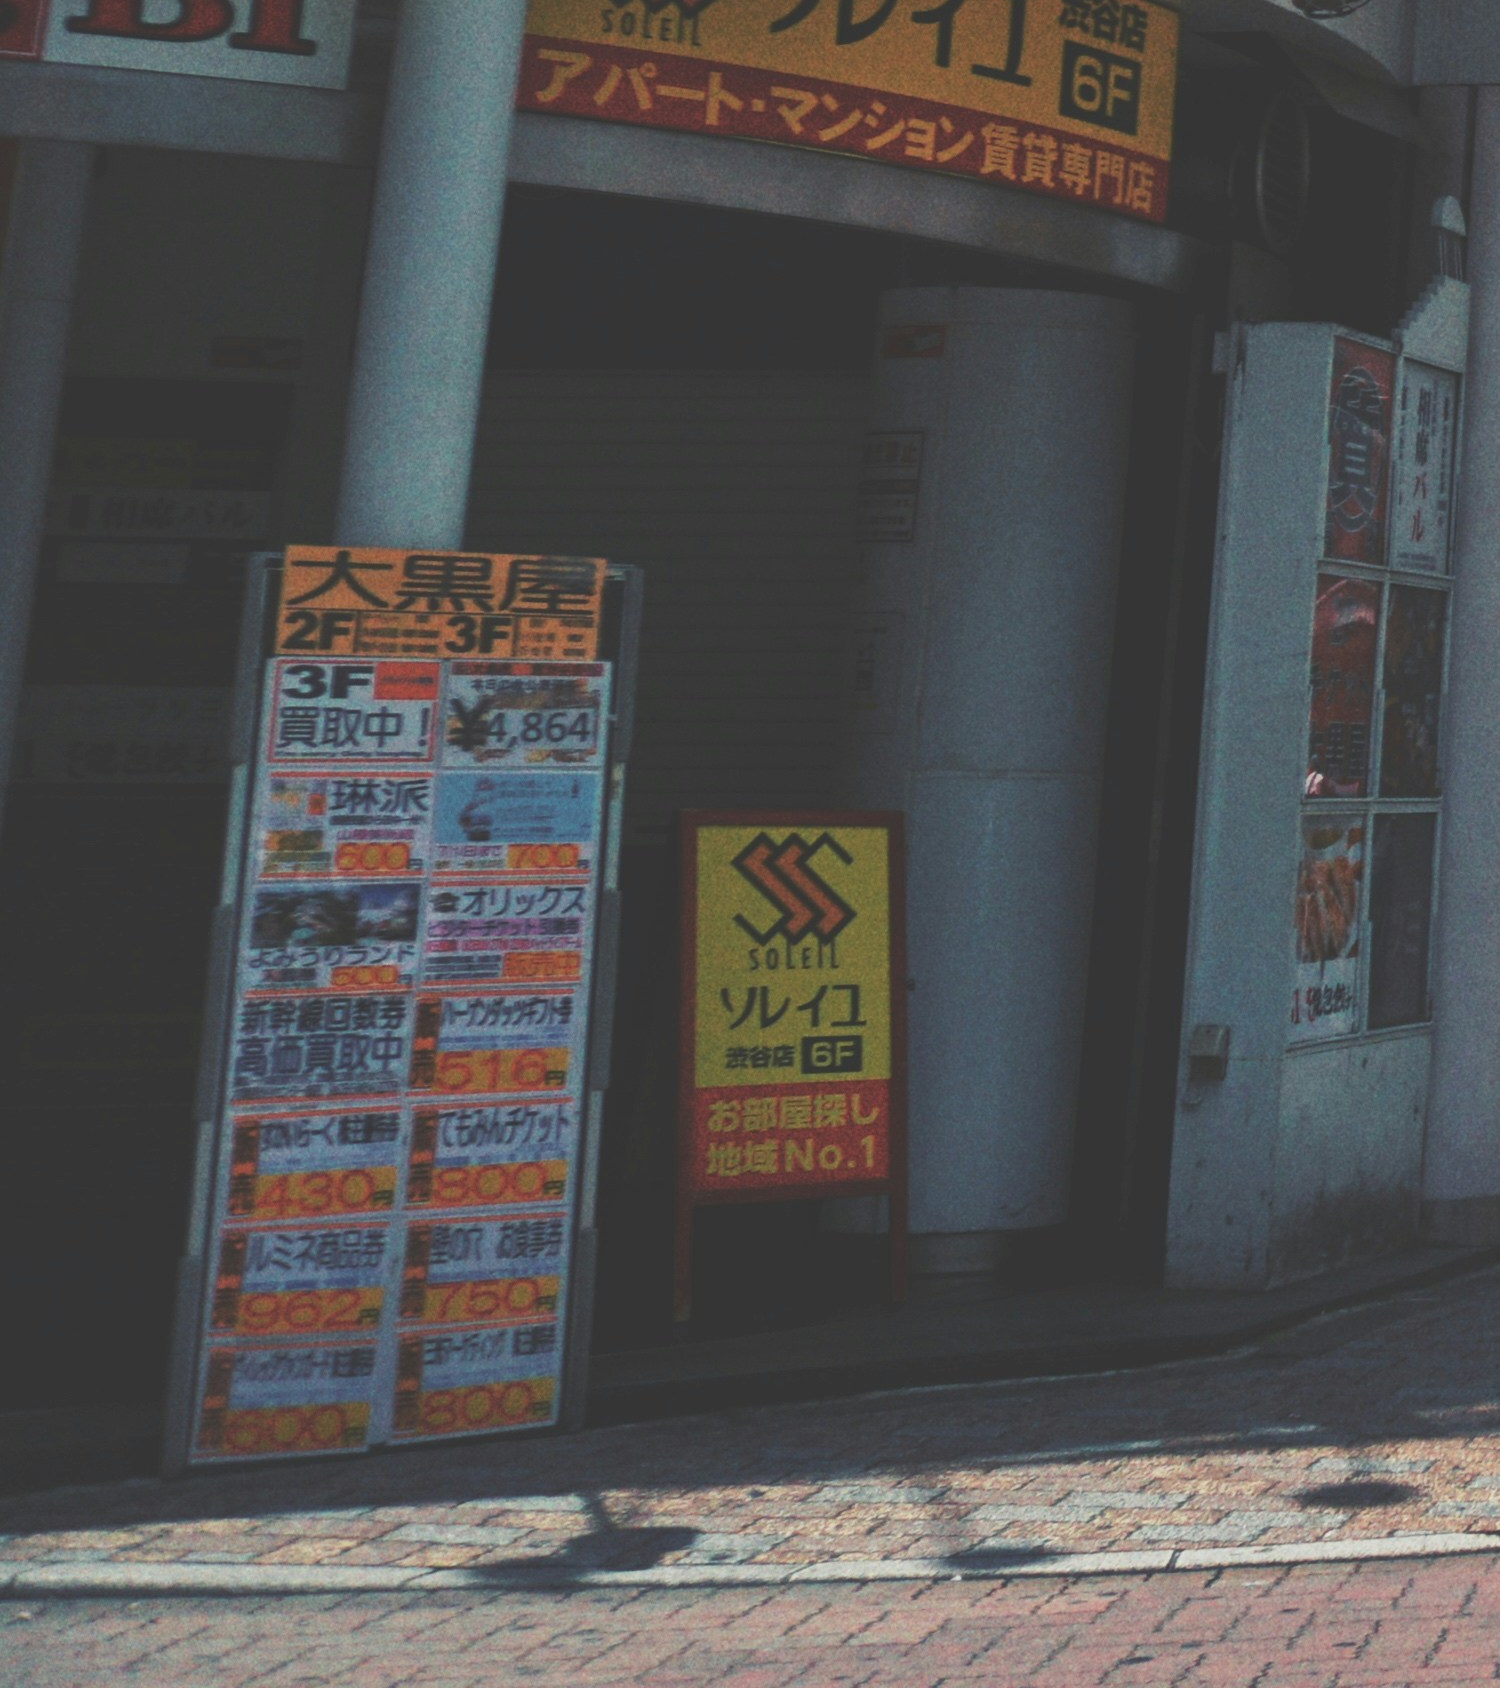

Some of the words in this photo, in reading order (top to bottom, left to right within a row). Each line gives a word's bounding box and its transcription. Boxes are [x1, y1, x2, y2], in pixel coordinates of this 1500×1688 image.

[598, 8, 700, 47] SOLEIL
[1071, 64, 1133, 118] 6F
[533, 48, 1155, 216] アパート・マンション賃貸専門店
[286, 550, 601, 614] 大黒屋
[280, 614, 355, 651] 2F
[444, 616, 513, 654] 3F
[282, 665, 374, 700] 3F
[275, 705, 432, 750] 買取中!
[328, 780, 431, 814] 琳派
[463, 887, 587, 916] オリックス
[249, 945, 417, 969] よみうりランド
[748, 937, 840, 971] SOLEIL
[242, 998, 408, 1034] 新幹線回数券
[721, 983, 867, 1031] ソレイユ
[236, 1033, 402, 1075] 高価買取中
[435, 1050, 567, 1091] 516円
[724, 1044, 794, 1069] 渋谷店
[810, 1040, 855, 1068] 6F
[706, 1091, 879, 1134] お部屋探し
[706, 1134, 876, 1178] 地域No.1
[434, 1160, 564, 1203] 800円
[237, 1284, 382, 1330] 962円
[425, 1278, 558, 1323] 750円
